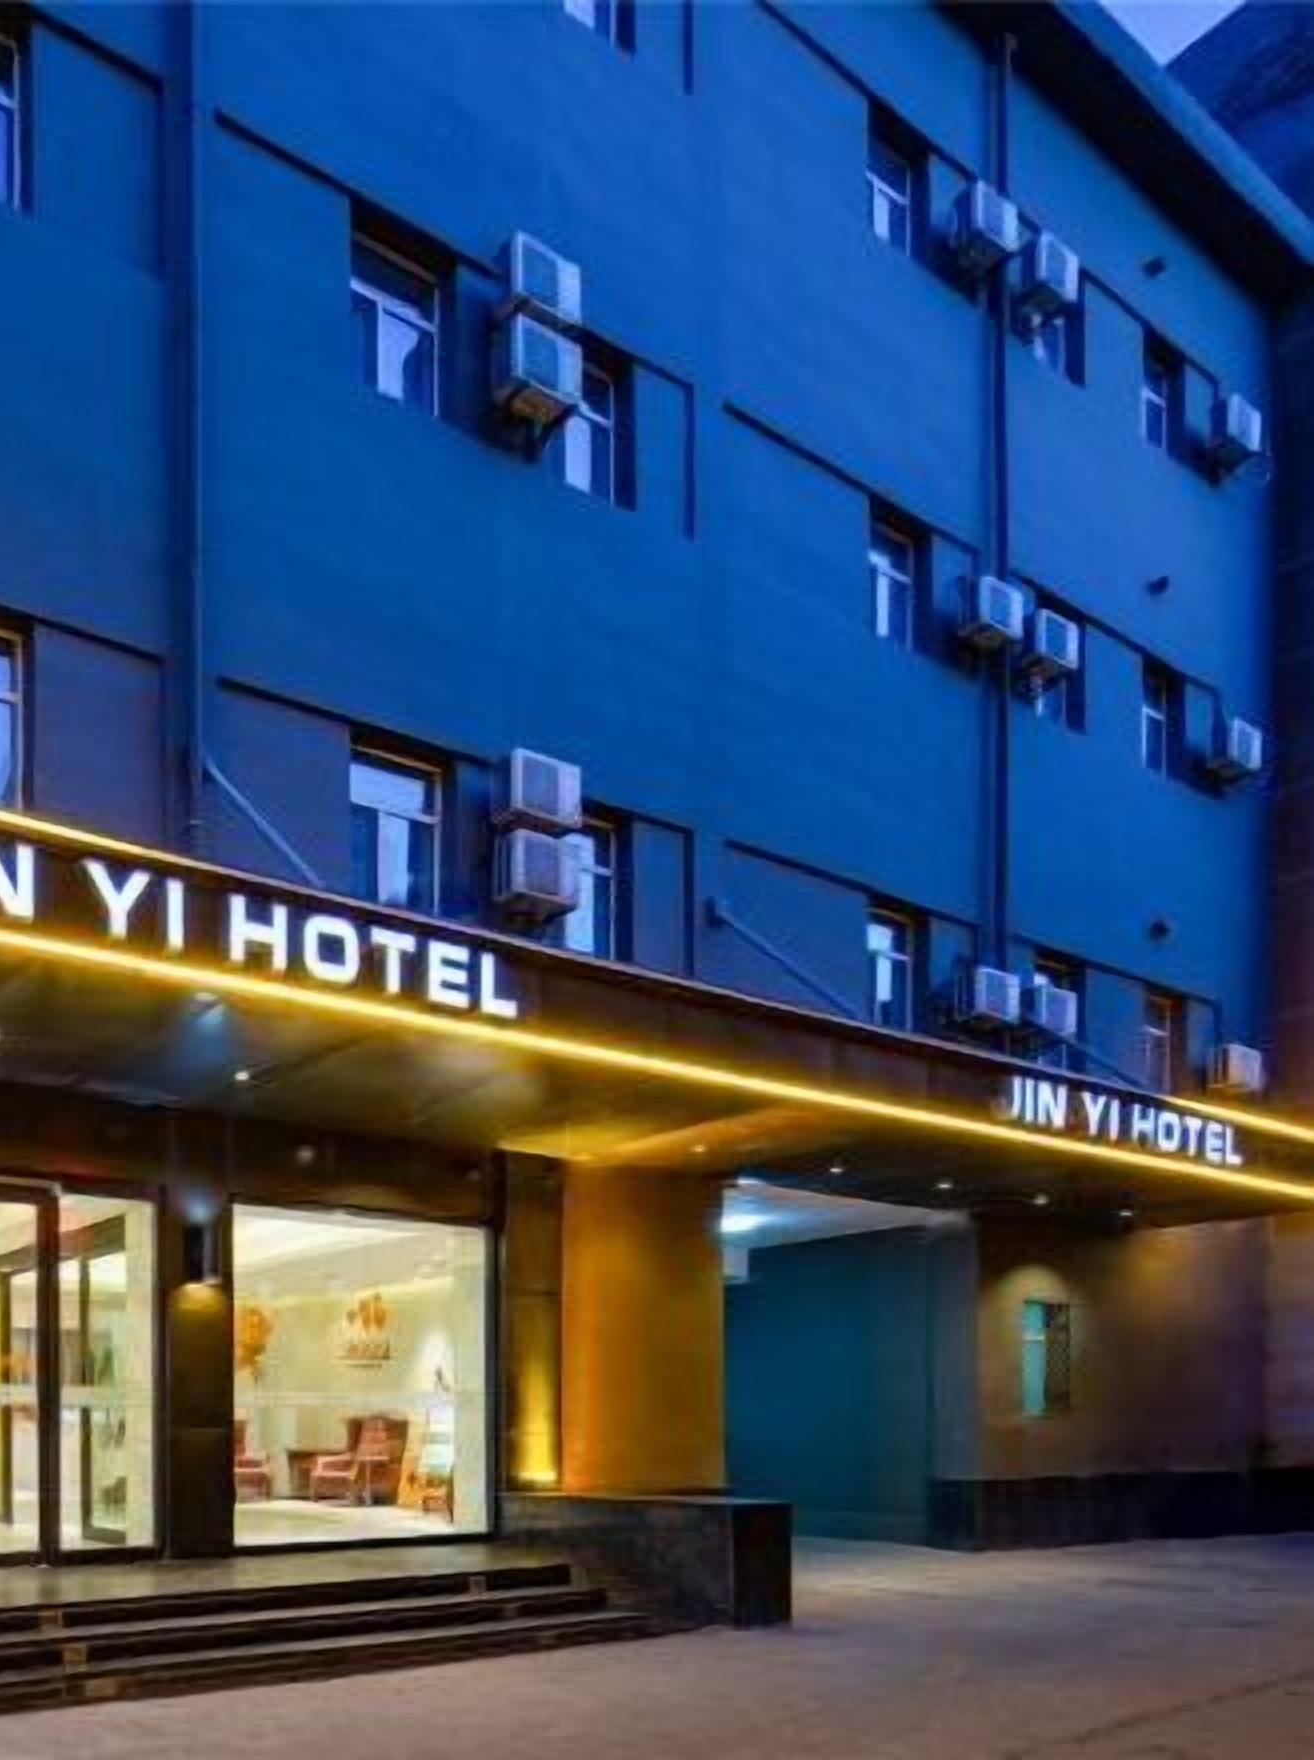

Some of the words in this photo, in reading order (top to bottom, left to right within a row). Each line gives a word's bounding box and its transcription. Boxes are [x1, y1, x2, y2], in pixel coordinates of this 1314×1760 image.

[84, 858, 185, 953] YI
[228, 893, 520, 1019] HOTEL
[999, 1075, 1068, 1128] JIN
[1082, 1091, 1120, 1142] YI
[1132, 1103, 1244, 1167] HOTEL
